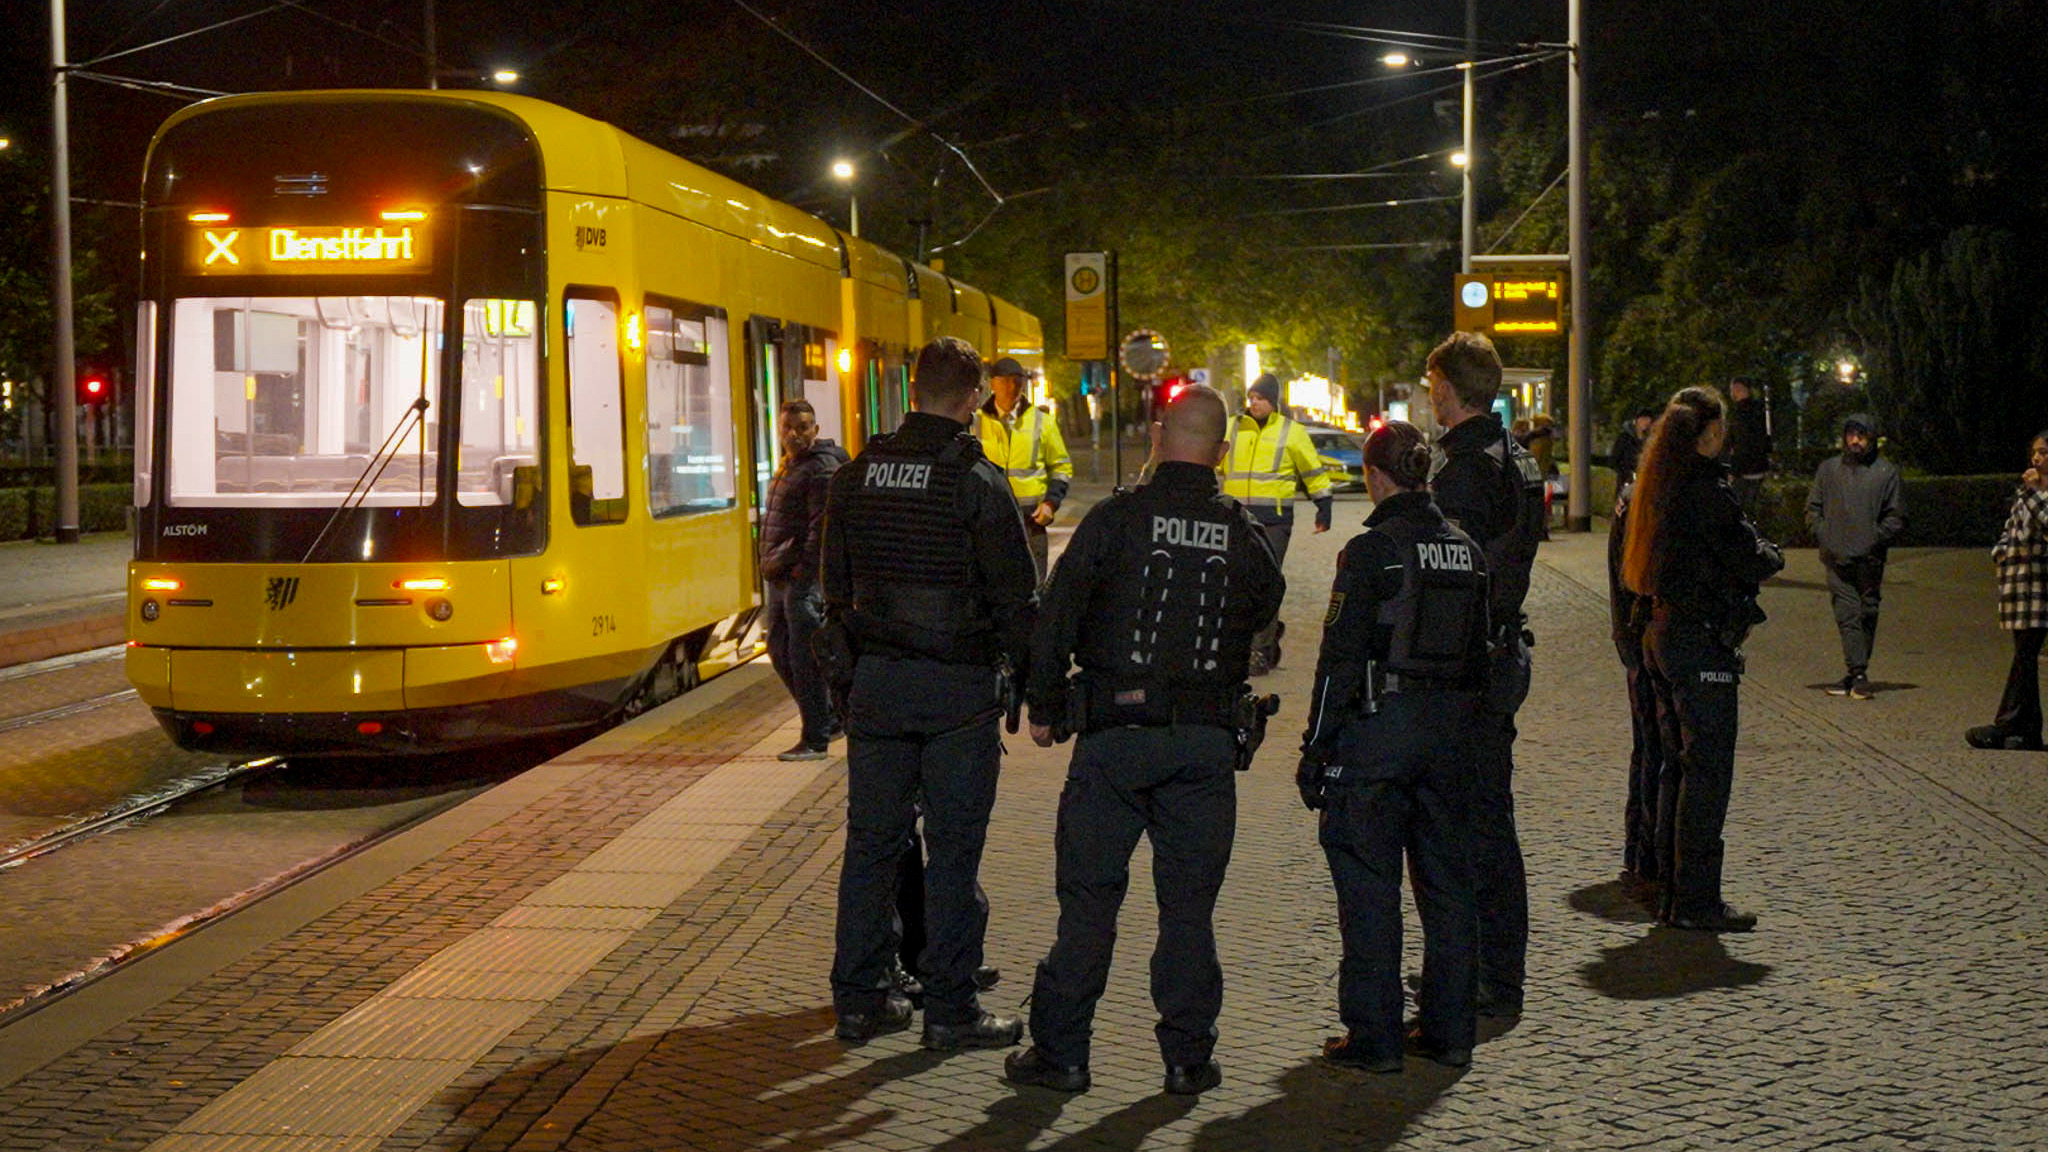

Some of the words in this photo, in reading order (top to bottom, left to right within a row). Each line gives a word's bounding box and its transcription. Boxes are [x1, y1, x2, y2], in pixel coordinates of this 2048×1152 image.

[270, 227, 414, 261] Dienstfahrt
[586, 227, 607, 247] DVB
[864, 462, 931, 489] POLIZEI
[163, 524, 208, 537] ALSTOM
[1152, 516, 1229, 551] POLIZEI
[1416, 543, 1473, 571] POLIZEI
[592, 614, 616, 637] 2914
